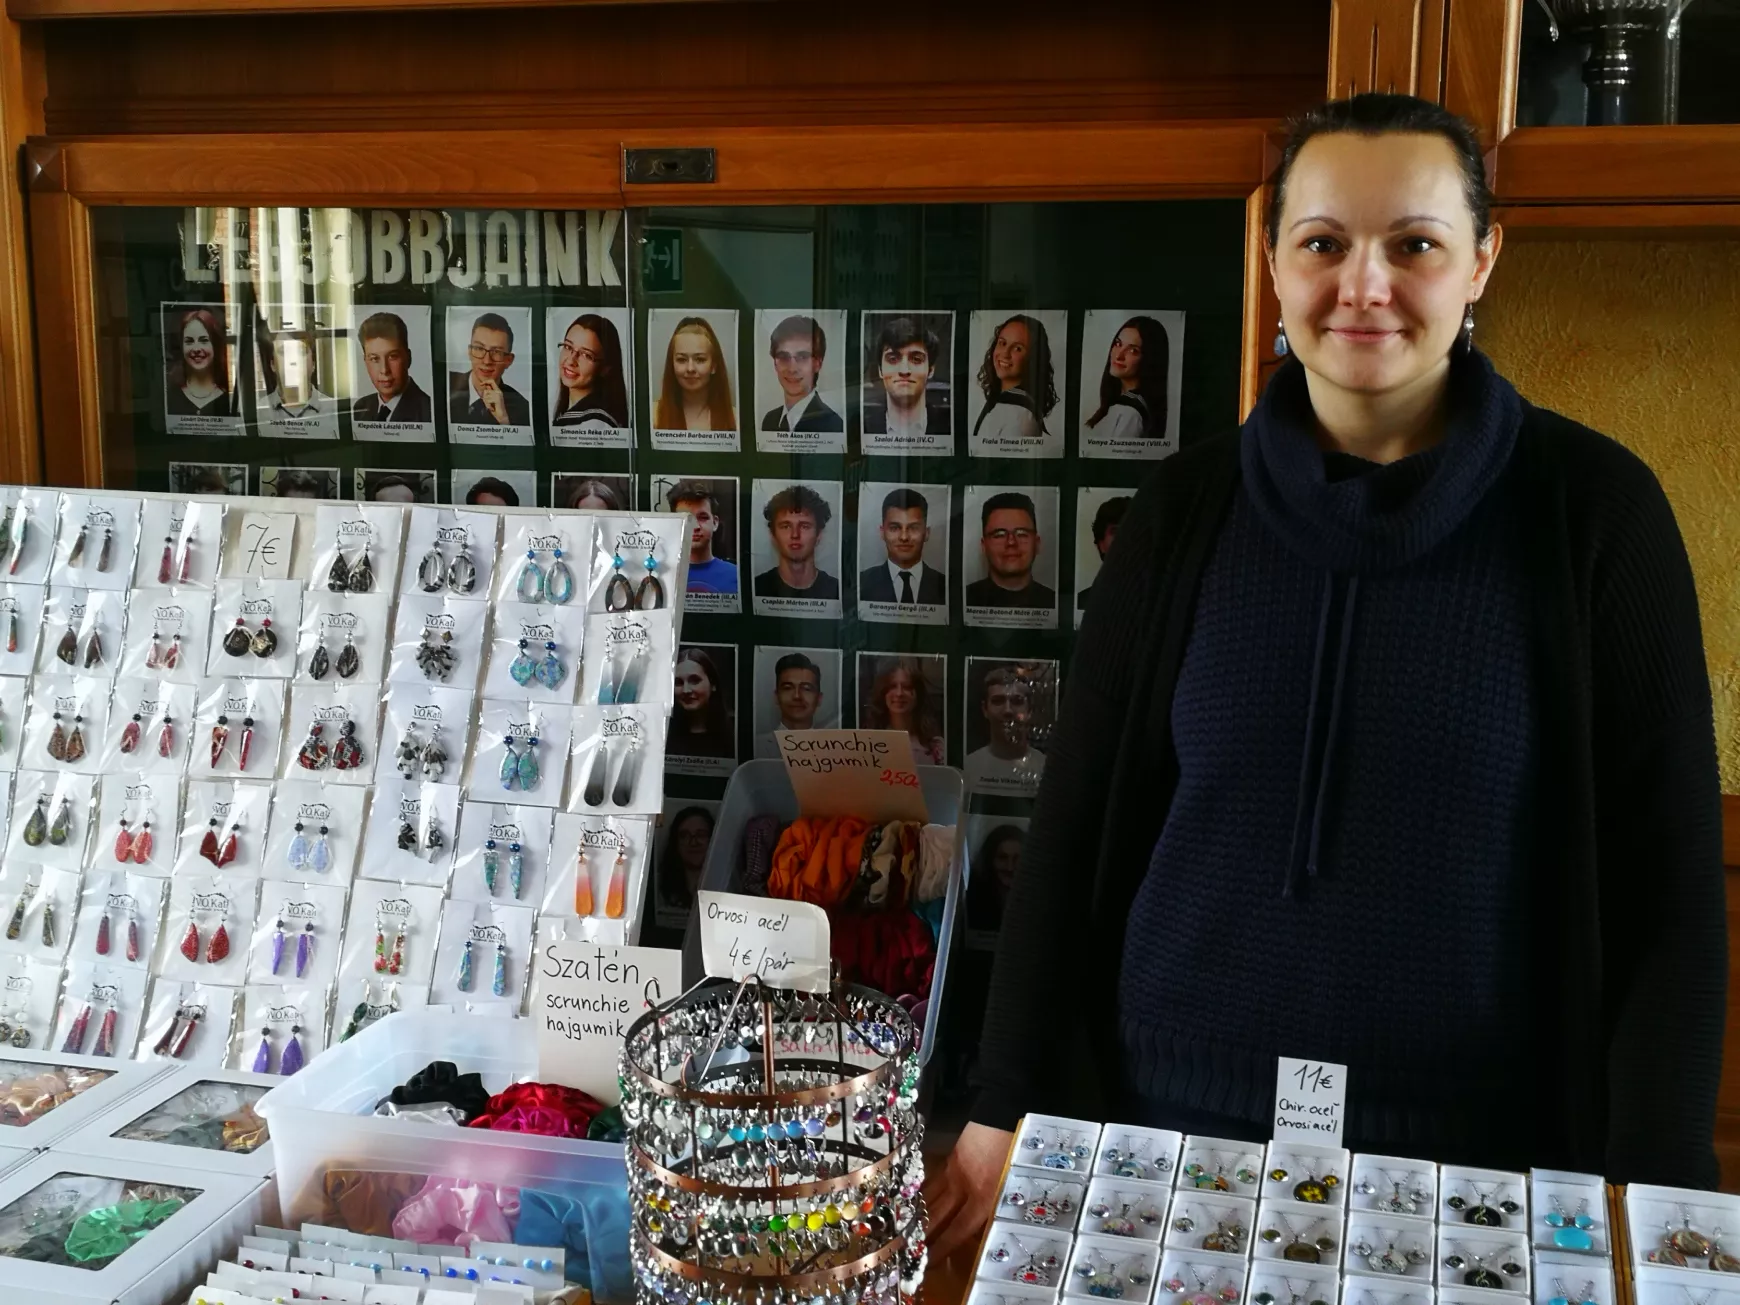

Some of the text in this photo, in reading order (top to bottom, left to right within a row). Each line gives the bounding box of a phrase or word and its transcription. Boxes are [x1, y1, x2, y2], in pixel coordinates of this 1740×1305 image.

[383, 422, 402, 430] László
[713, 432, 736, 440] (VIII.N)
[916, 436, 935, 444] (IV.C)
[1020, 438, 1044, 446] (VIII.N)
[246, 523, 281, 574] 7€
[784, 732, 889, 754] Scrunchie
[786, 754, 882, 773] hajgumik
[707, 902, 790, 932] Orvosi acél
[542, 944, 639, 984] Szatén
[546, 993, 631, 1013] scrunchie
[546, 1015, 628, 1041] hajgumik
[1293, 1063, 1334, 1093] 11€
[1277, 1116, 1311, 1130] Orvosi
